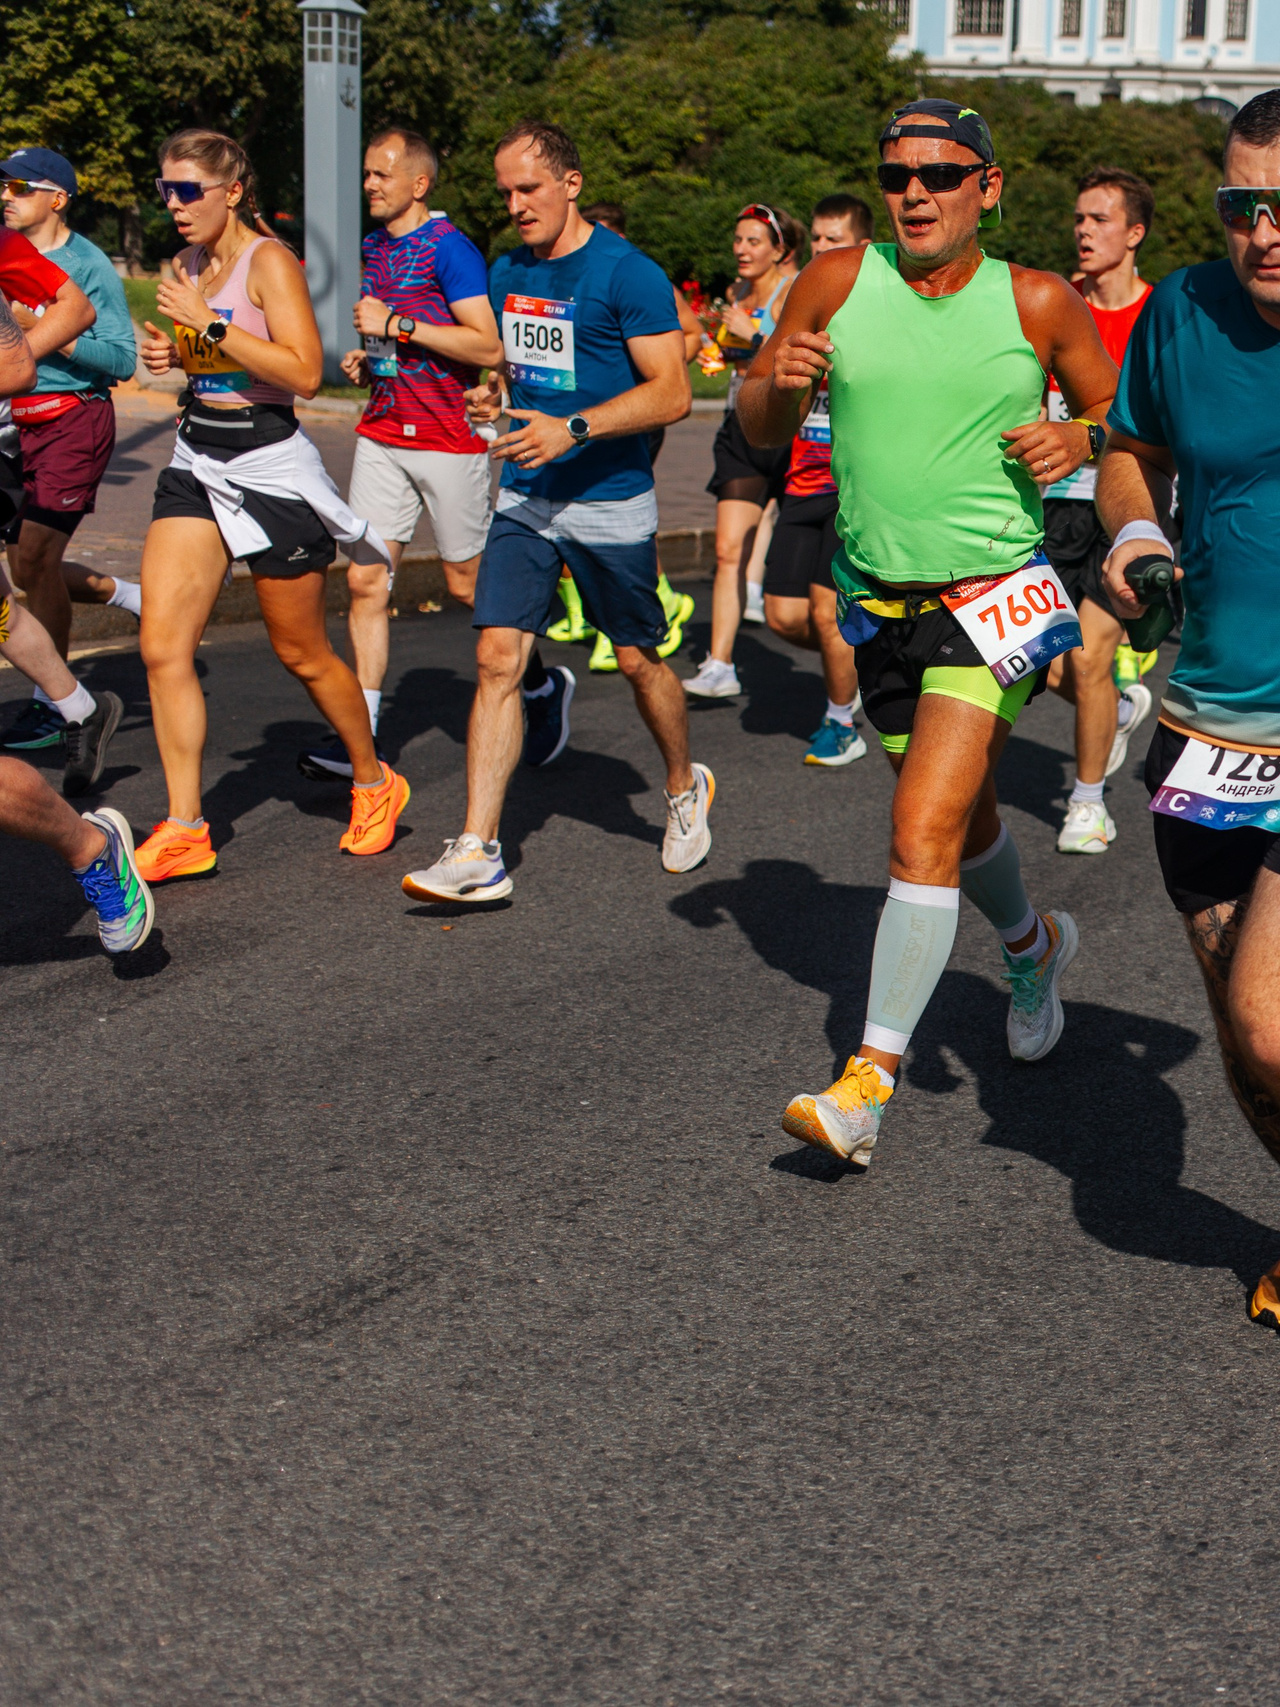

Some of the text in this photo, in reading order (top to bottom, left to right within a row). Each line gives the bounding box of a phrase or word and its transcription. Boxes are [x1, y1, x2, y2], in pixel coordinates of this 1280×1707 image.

[183, 330, 226, 359] 149
[512, 321, 564, 353] 1508
[524, 352, 548, 362] АНТОН
[12, 398, 60, 417] KEEP RUNNING
[960, 573, 997, 599] МАРАФОН
[977, 579, 1068, 641] 7602
[1007, 654, 1028, 676] D
[1215, 782, 1276, 797] АНДРЕЙ
[1168, 792, 1191, 812] C
